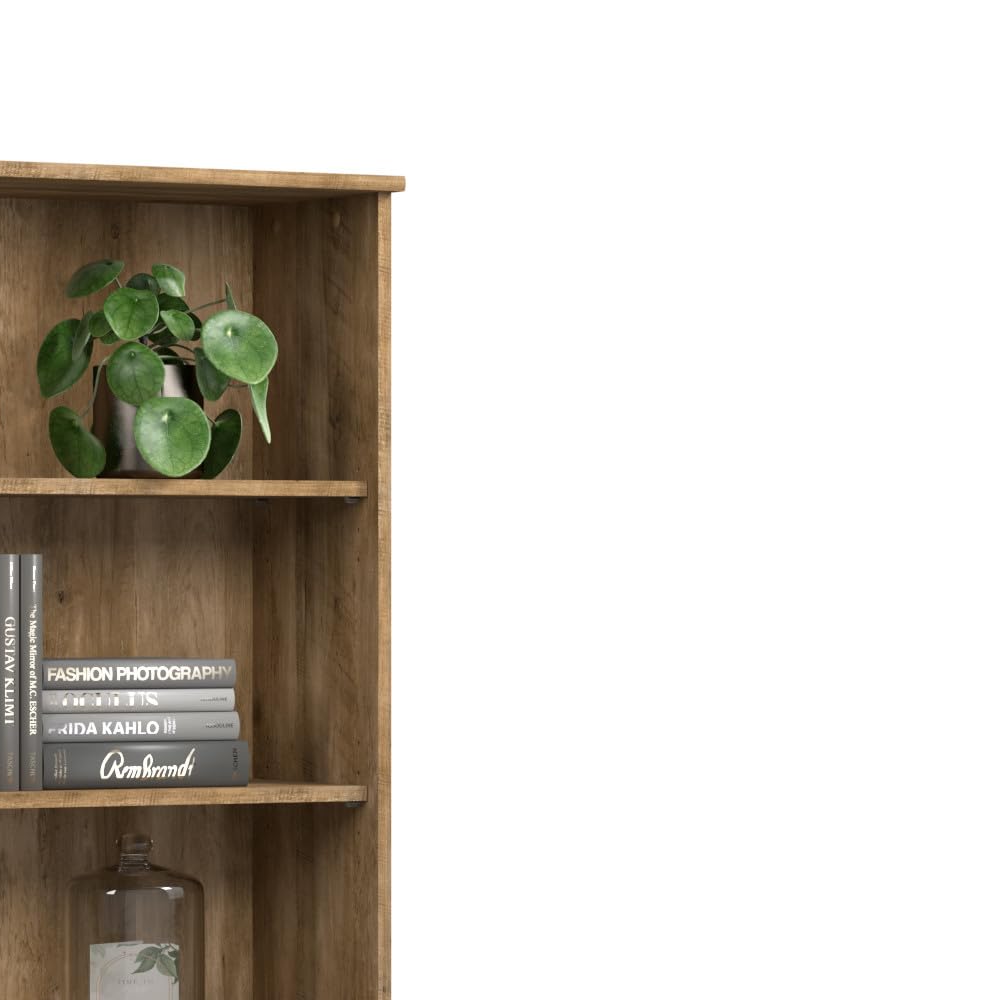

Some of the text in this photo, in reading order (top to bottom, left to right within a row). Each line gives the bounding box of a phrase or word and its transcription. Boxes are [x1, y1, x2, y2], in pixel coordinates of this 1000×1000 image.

[4, 616, 16, 673] GUSTAV
[47, 666, 232, 682] FASHION PHOTOGRAPHY
[29, 700, 37, 736] ESCHER
[102, 720, 159, 735] KAHLO
